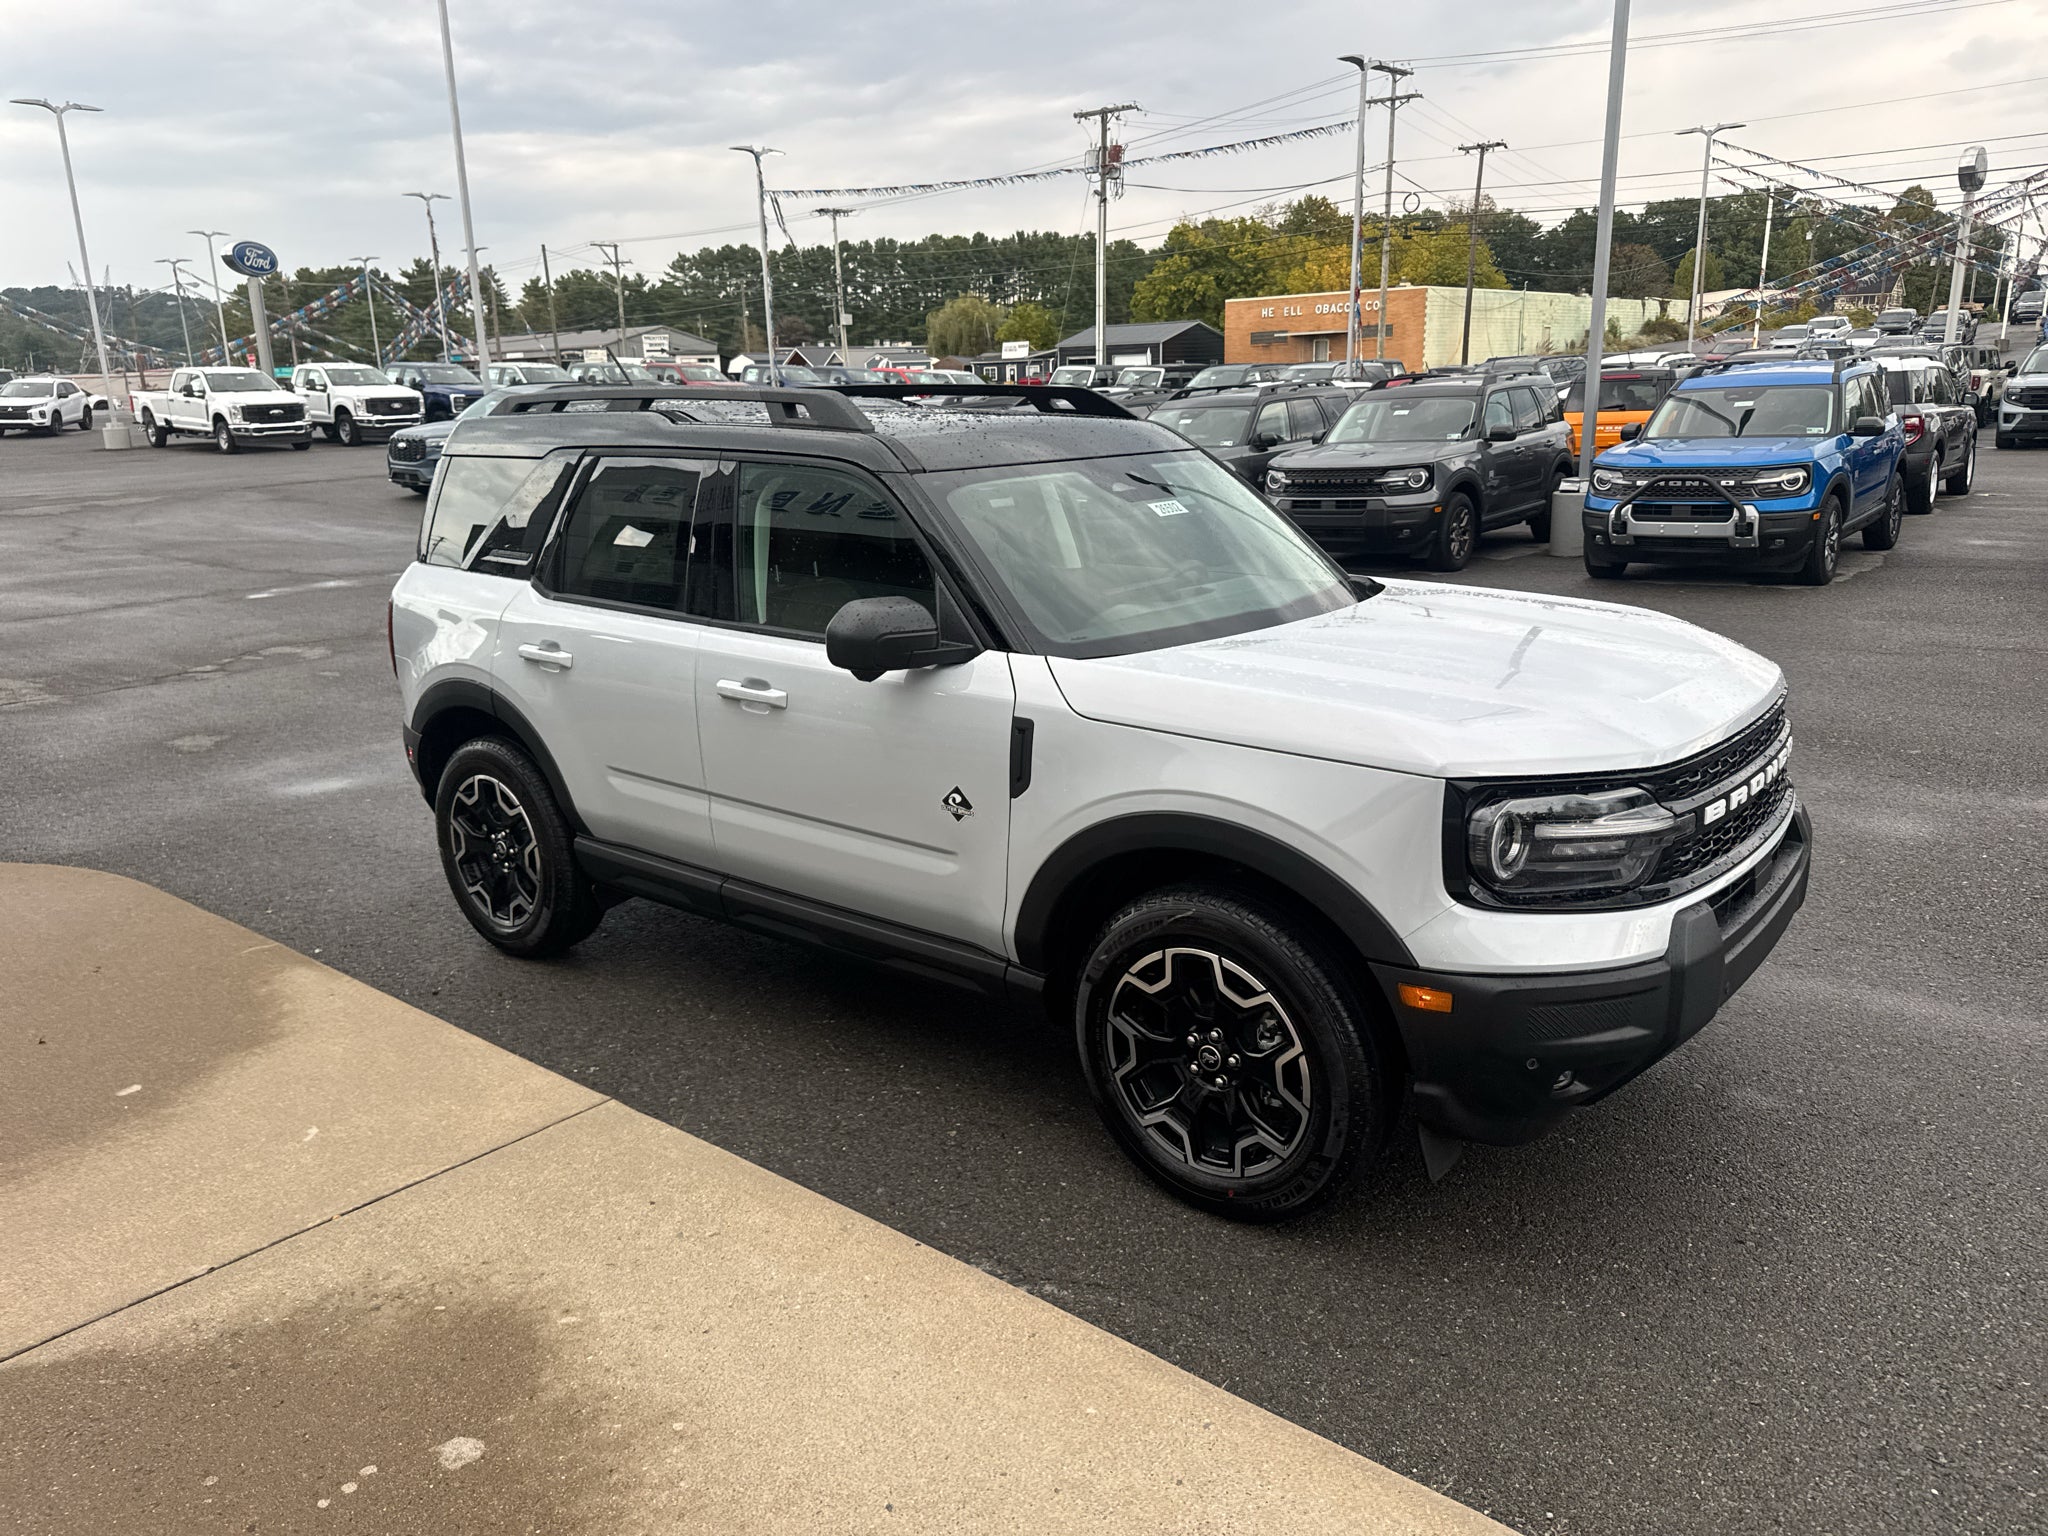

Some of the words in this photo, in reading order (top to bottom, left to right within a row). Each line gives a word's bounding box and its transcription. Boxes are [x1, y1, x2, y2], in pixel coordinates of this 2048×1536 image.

[244, 247, 271, 269] Ford
[1261, 307, 1275, 318] HE
[1283, 305, 1303, 317] ELL
[1315, 302, 1358, 315] OBACC
[1365, 300, 1380, 311] CO
